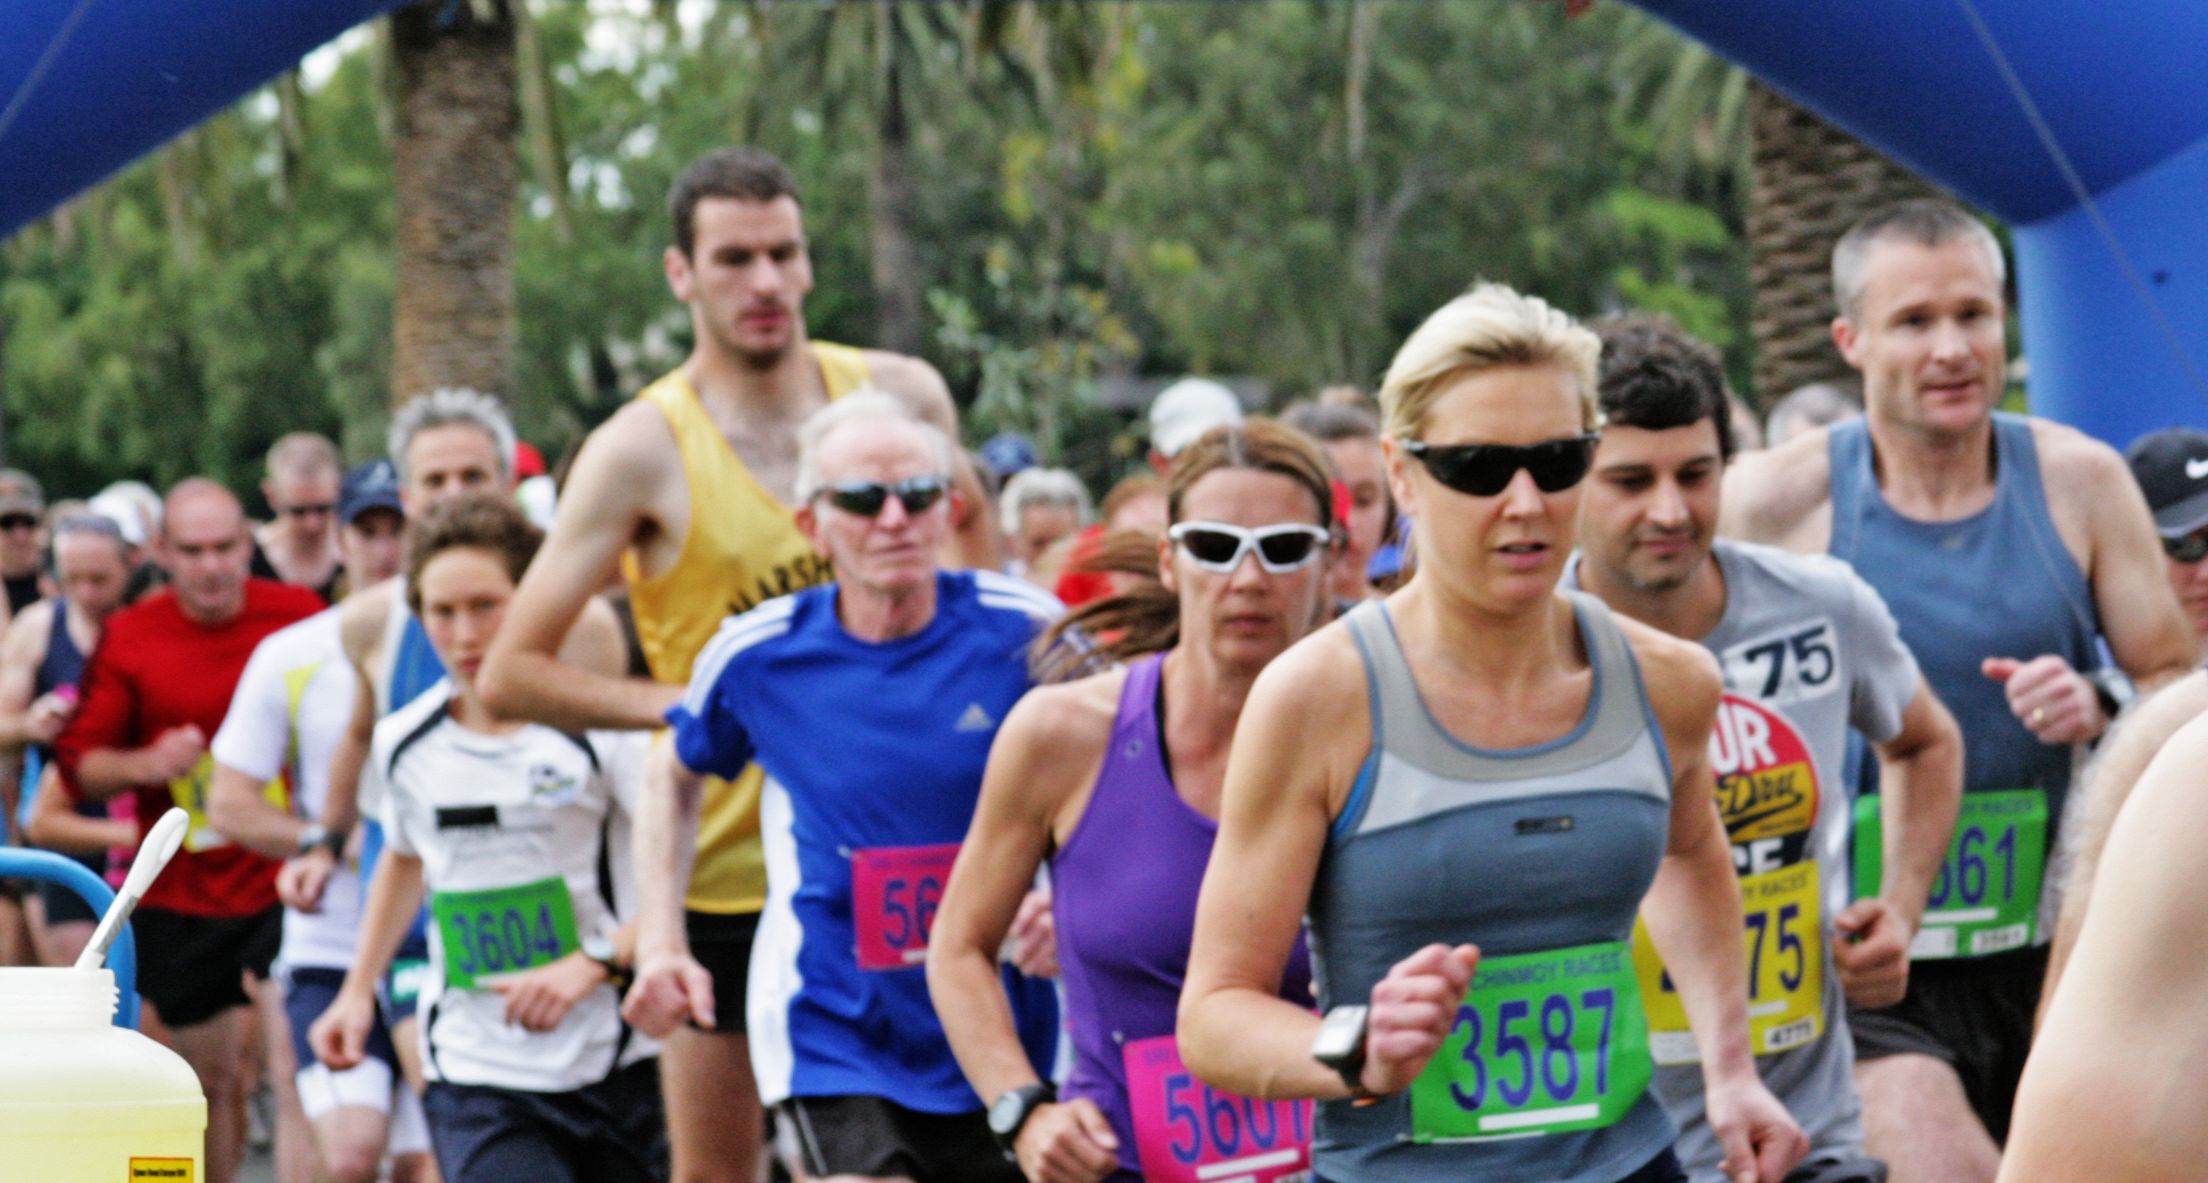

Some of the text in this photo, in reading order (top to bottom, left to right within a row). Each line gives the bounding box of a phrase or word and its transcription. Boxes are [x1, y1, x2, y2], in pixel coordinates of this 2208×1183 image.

[1744, 625, 1833, 698] 75
[453, 903, 560, 974] 3604
[1563, 951, 1621, 977] RACES
[1450, 988, 1614, 1111] 3587
